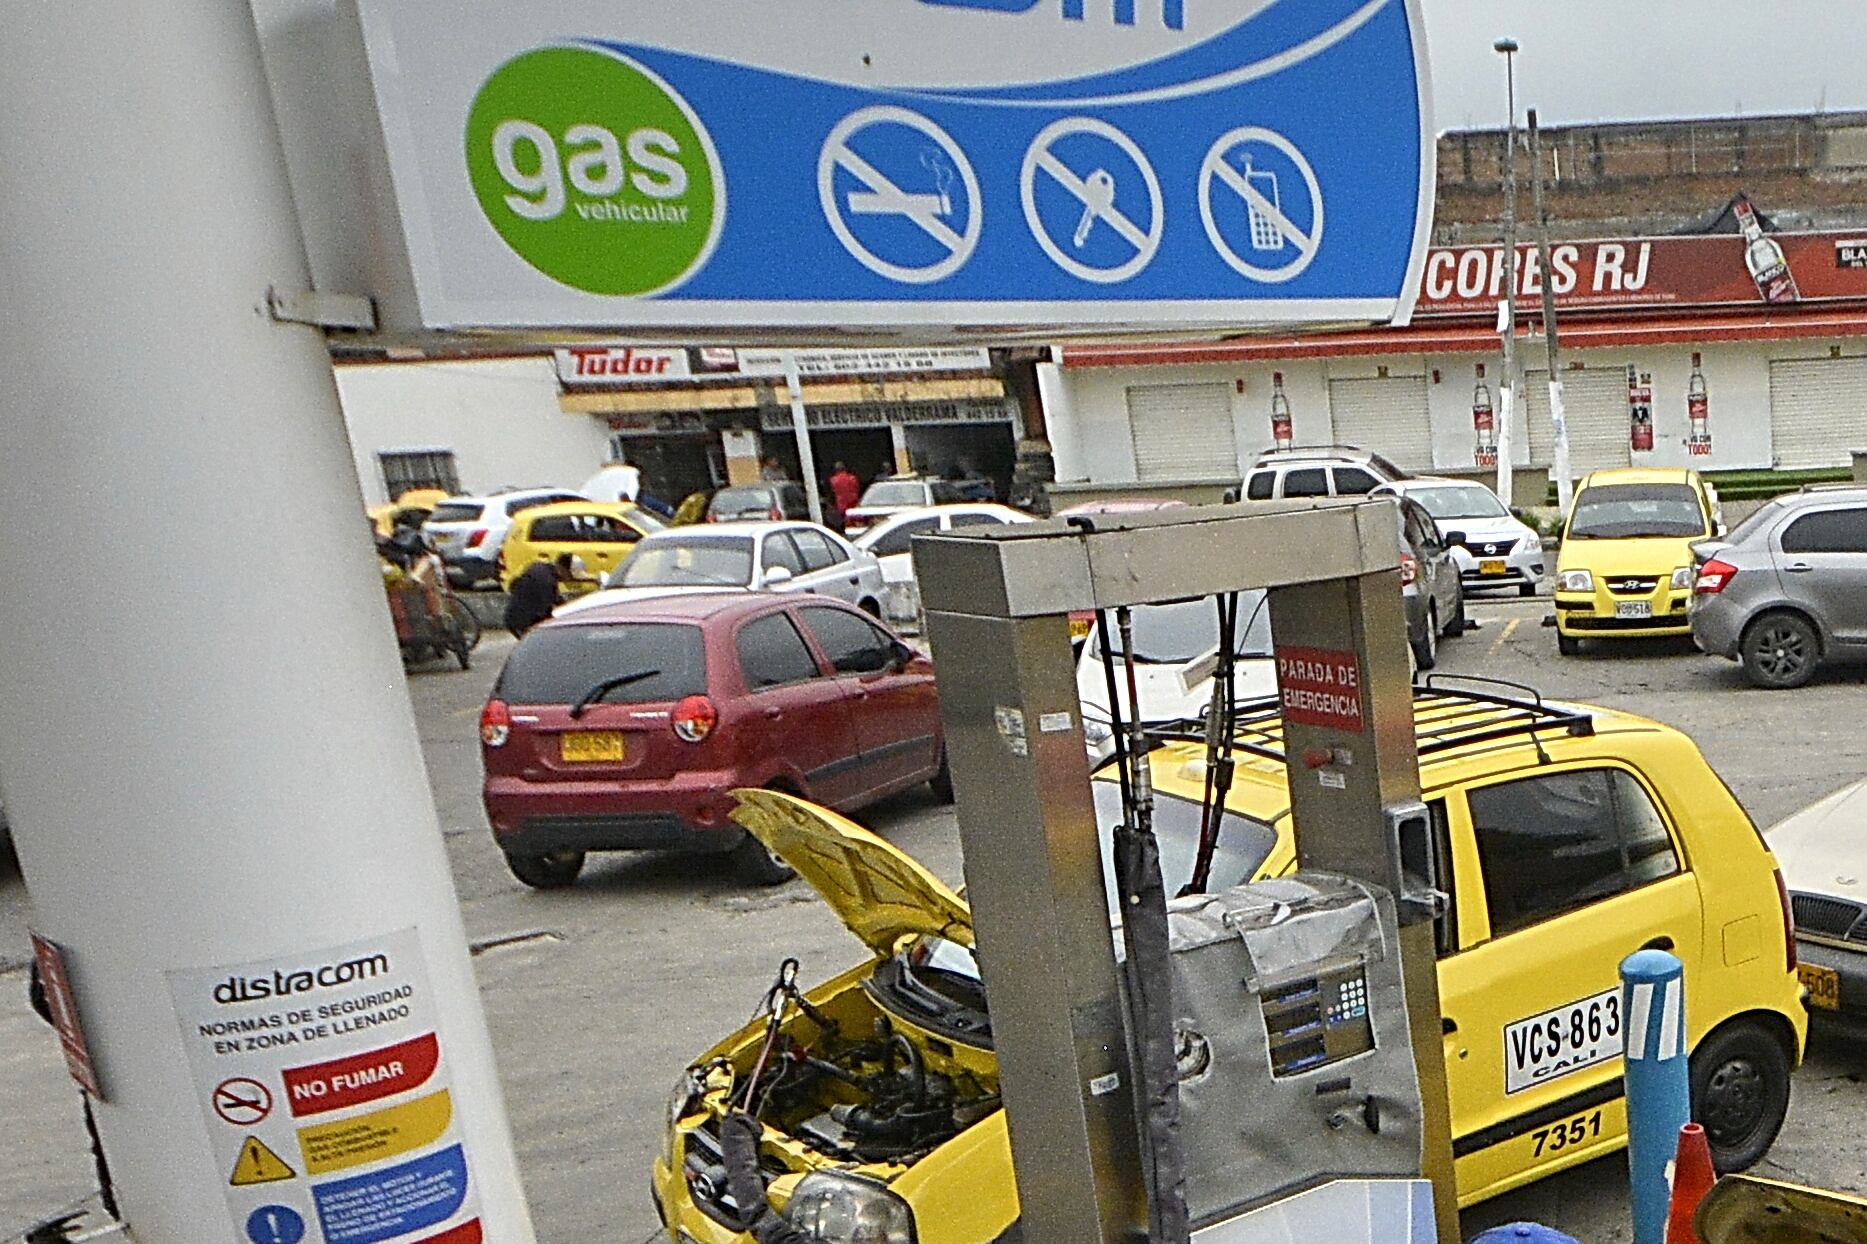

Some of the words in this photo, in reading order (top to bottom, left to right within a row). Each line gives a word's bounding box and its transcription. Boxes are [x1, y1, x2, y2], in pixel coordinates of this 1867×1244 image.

[492, 120, 688, 221] gas
[575, 199, 689, 223] vehicular
[1426, 245, 1579, 299] CORES
[1592, 242, 1651, 291] RJ
[569, 347, 671, 375] Tudor
[1280, 659, 1333, 682] PARADA
[1338, 666, 1357, 687] DE
[1283, 688, 1359, 716] EMERGENCIA
[213, 953, 389, 1005] distracom
[199, 1014, 283, 1037] NORMAS
[288, 1010, 314, 1025] DE
[318, 984, 414, 1020] SEGURIDAD
[214, 1039, 241, 1054] EN
[246, 1033, 300, 1052] ZONA
[303, 1025, 330, 1040] DE
[333, 1004, 410, 1036] LLENADO
[293, 1080, 328, 1100] NO
[332, 1061, 405, 1093] FUMAR
[1532, 1049, 1598, 1078] CALI
[1532, 1111, 1601, 1158] 7351
